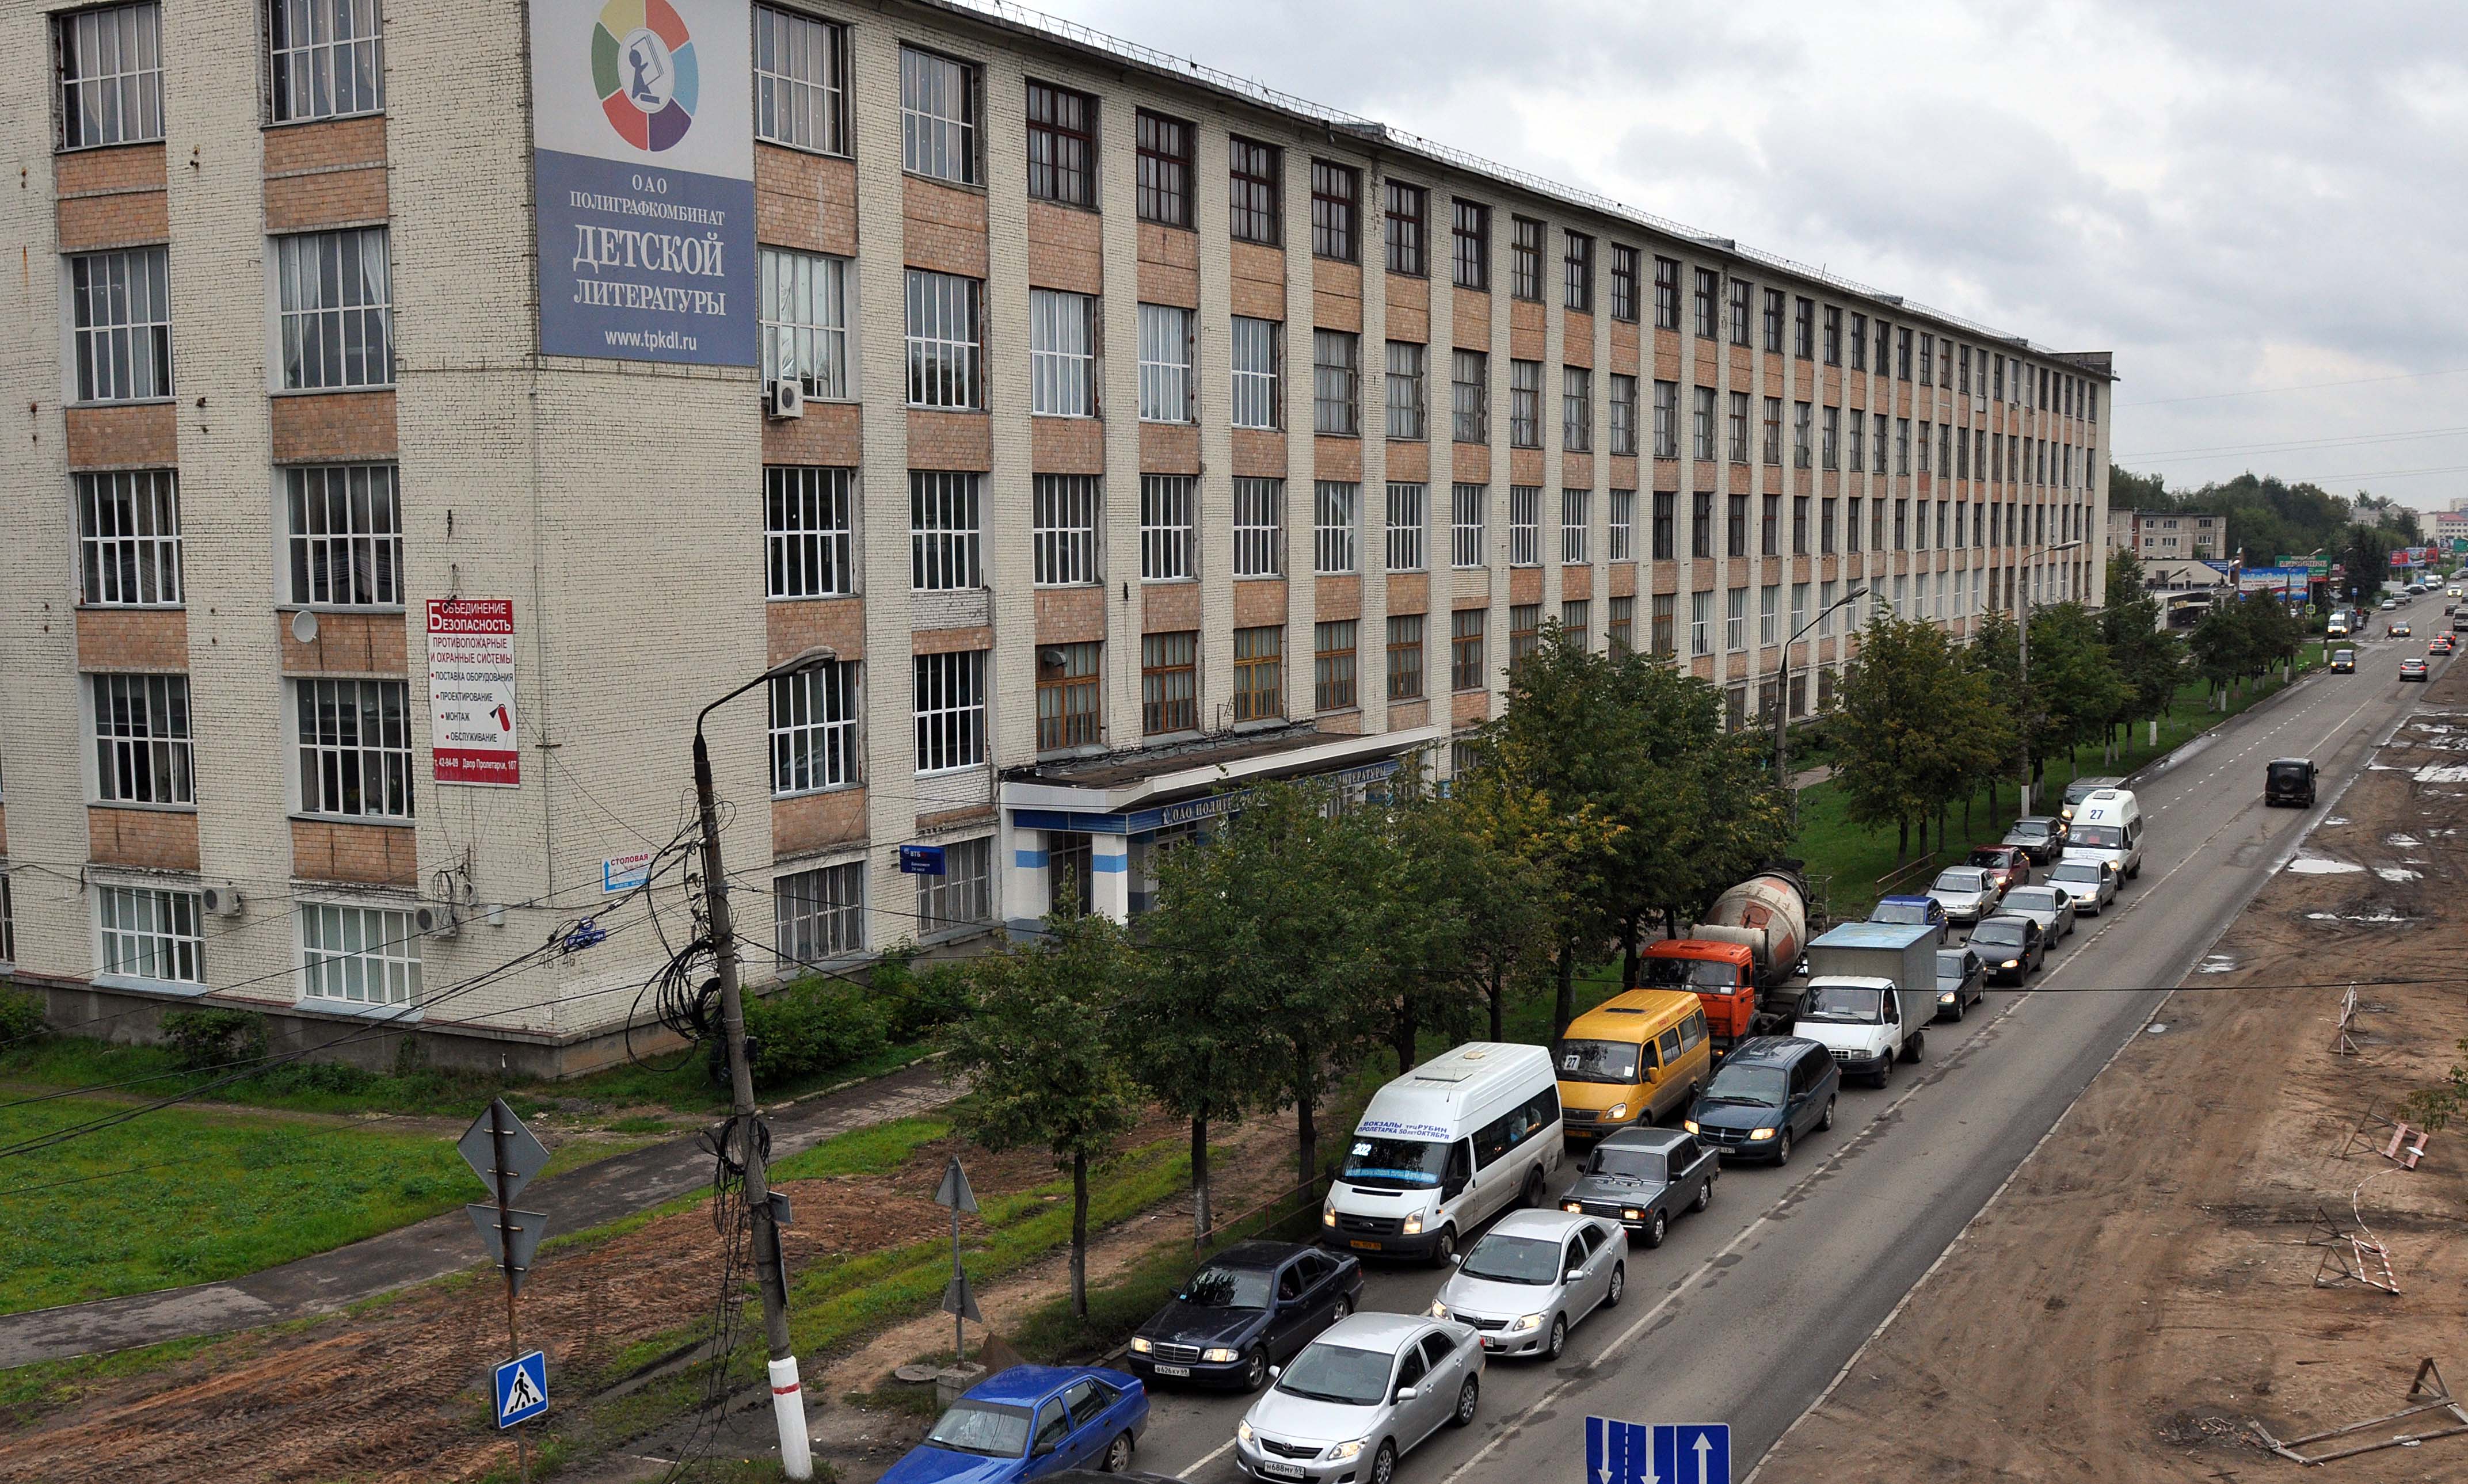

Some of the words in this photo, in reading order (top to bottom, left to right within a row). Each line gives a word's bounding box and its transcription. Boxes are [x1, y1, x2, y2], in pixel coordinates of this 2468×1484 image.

[632, 174, 667, 194] ОАО
[570, 190, 725, 226] ПОЛИГРАФКОМБИНАТ
[573, 224, 725, 277] ДЕТСКОЙ
[574, 279, 726, 316] ЛИТЕРАТУРЫ
[605, 330, 697, 350] www.tpkdl.ru
[433, 637, 508, 648] ПРОТИВОПОЖАРНЫЕ
[431, 653, 435, 662] И
[437, 653, 475, 663] ОХРАННЫЕ
[477, 653, 512, 664] СИСТЕМЫ
[435, 672, 465, 681] ПОСТАВКА
[466, 672, 513, 683] ОБОРУДОВАНИЯ
[440, 692, 493, 701] ПРОЕКТИРОВАНИЕ
[445, 712, 470, 721] МОНТАЖ
[451, 732, 497, 742] ОБСЛУЖИВАНИЕ
[1172, 806, 1192, 822] ОАО
[2089, 809, 2104, 819] 27
[611, 853, 649, 865] СТОЛОВАЯ
[1566, 1057, 1578, 1069] 27
[1418, 1124, 1447, 1133] РУБИН
[1416, 1130, 1450, 1139] ОКТЯБРЯ
[1352, 1143, 1372, 1156] 202
